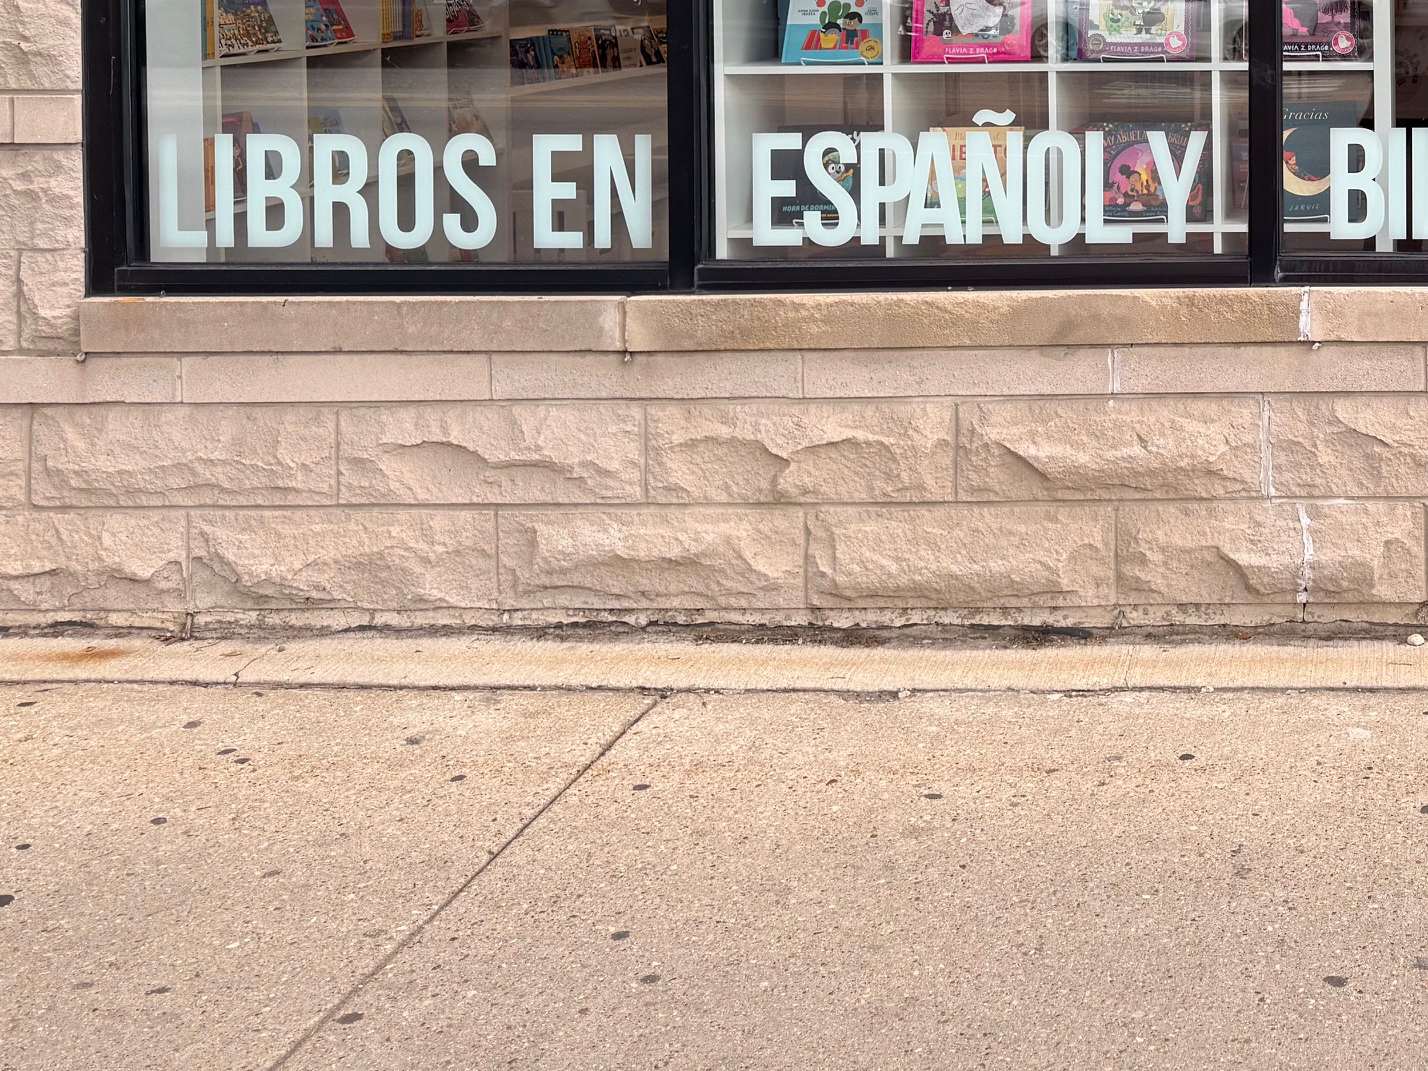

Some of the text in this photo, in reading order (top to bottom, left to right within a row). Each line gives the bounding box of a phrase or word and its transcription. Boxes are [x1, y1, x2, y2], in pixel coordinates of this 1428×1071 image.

[158, 132, 498, 250] LIBROS
[532, 133, 653, 250] EN
[752, 108, 1133, 247] ESPAÑOL
[1145, 130, 1209, 245] Y
